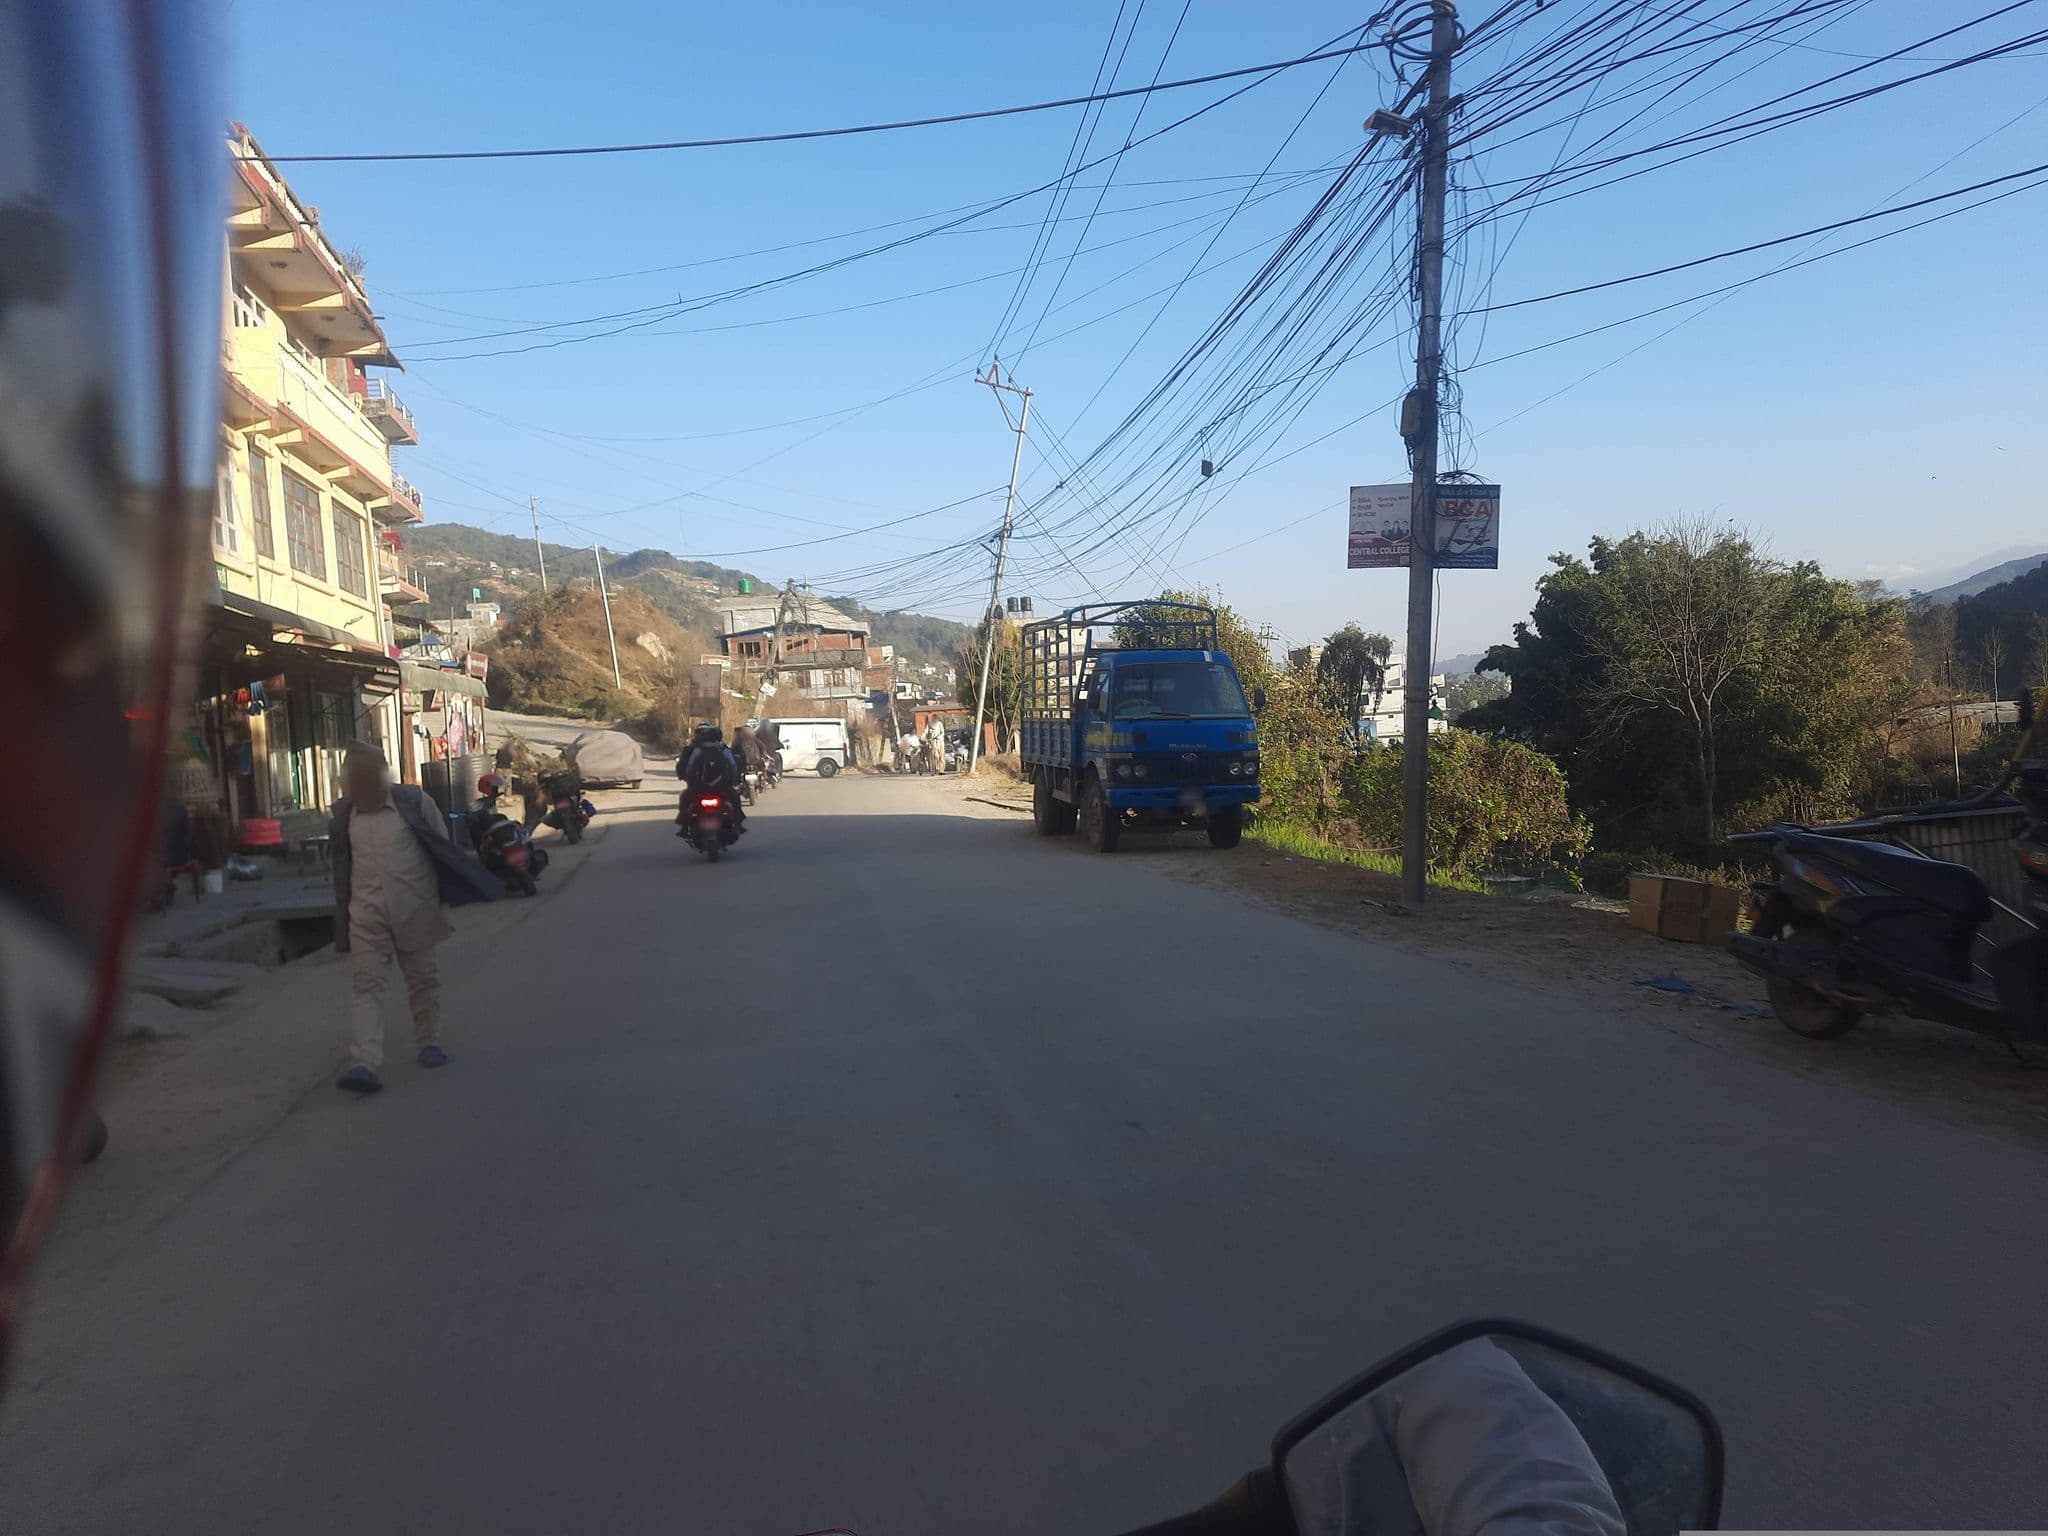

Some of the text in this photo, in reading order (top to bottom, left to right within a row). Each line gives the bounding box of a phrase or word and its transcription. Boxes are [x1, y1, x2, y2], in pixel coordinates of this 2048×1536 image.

[1444, 500, 1489, 516] BCA
[1349, 546, 1410, 556] CENTRAL COLLEGE
